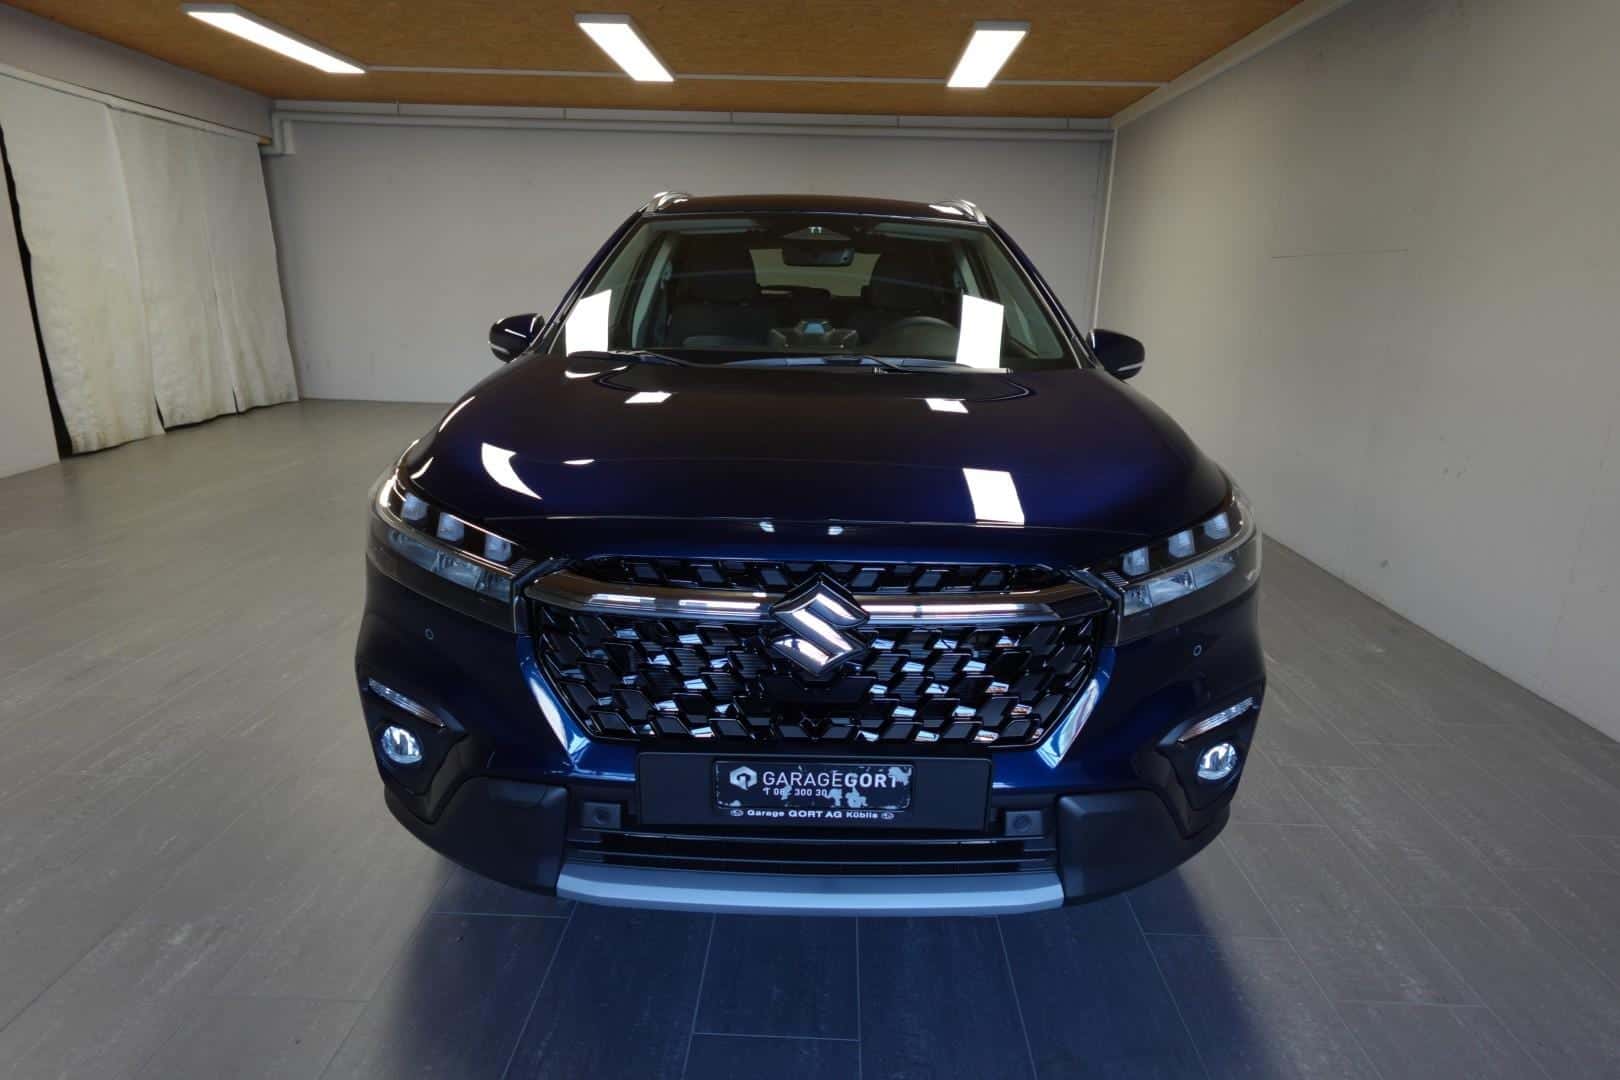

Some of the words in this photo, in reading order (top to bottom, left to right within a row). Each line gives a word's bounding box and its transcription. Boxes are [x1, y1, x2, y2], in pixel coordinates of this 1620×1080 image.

[794, 788, 813, 797] 300
[747, 809, 785, 818] Garage
[788, 809, 823, 819] GORT
[825, 811, 842, 819] AG
